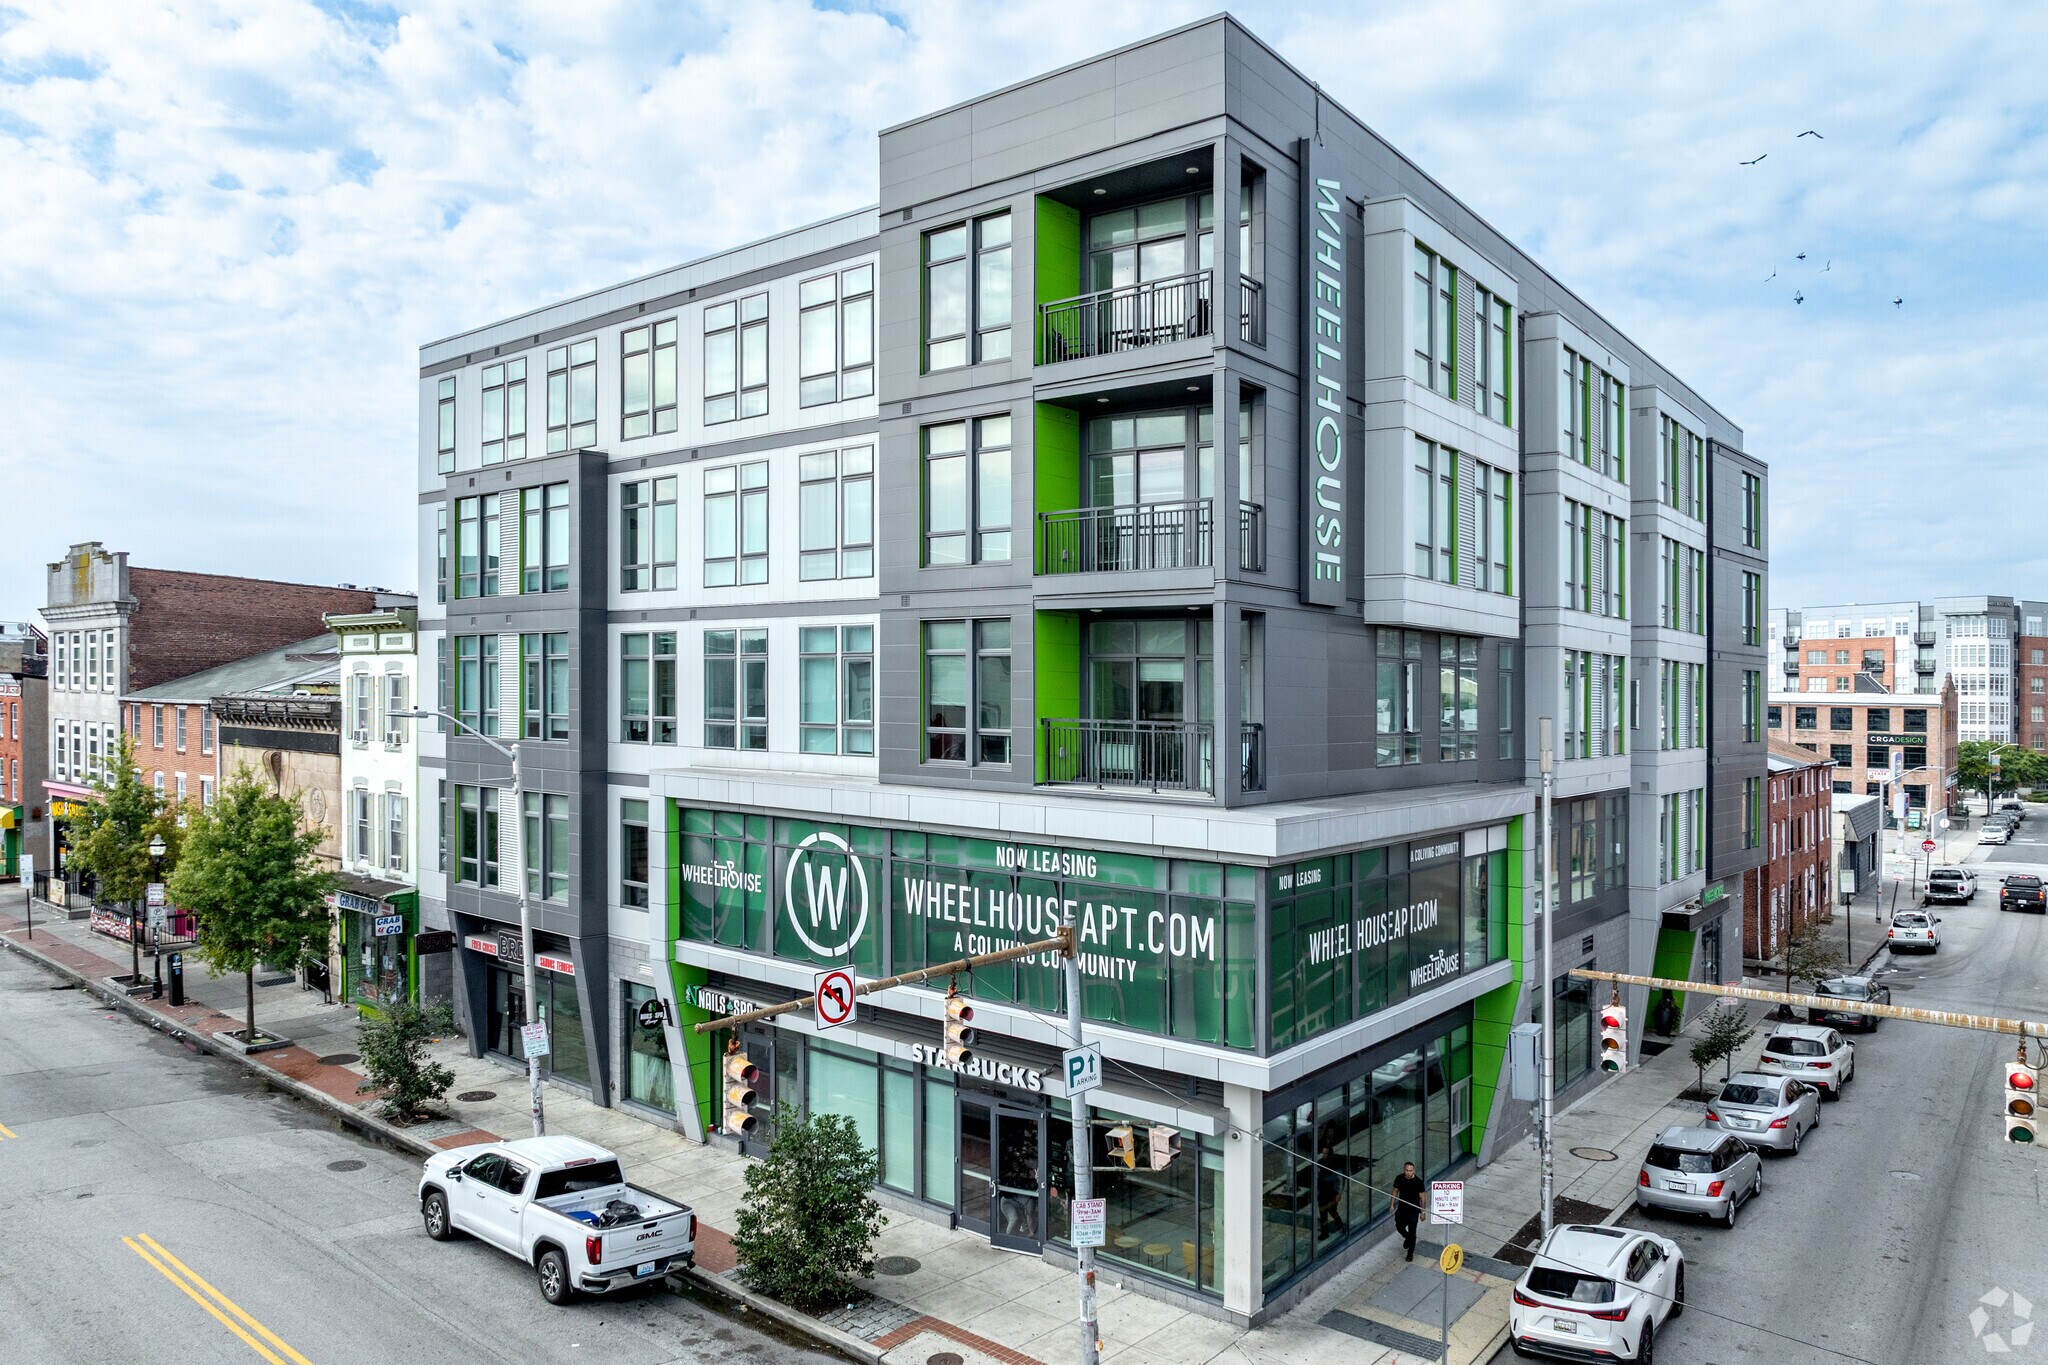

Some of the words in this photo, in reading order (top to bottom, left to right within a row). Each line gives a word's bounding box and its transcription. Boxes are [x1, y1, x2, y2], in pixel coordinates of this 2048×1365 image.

[1315, 177, 1341, 583] WHEELHOUSE
[996, 846, 1028, 869] NOW
[1033, 850, 1097, 878] LEASING
[682, 861, 762, 893] WHEELHOUSE
[1279, 874, 1293, 891] NOW
[1296, 868, 1322, 887] LEASING
[340, 894, 359, 909] GRAB
[367, 901, 378, 914] GO
[804, 862, 847, 931] W
[377, 916, 400, 926] GRAB
[386, 925, 401, 934] GO
[954, 931, 964, 953] A
[1410, 950, 1459, 988] WHEELHOUSE
[698, 990, 726, 1014] NAILS
[636, 1229, 663, 1240] GMC
